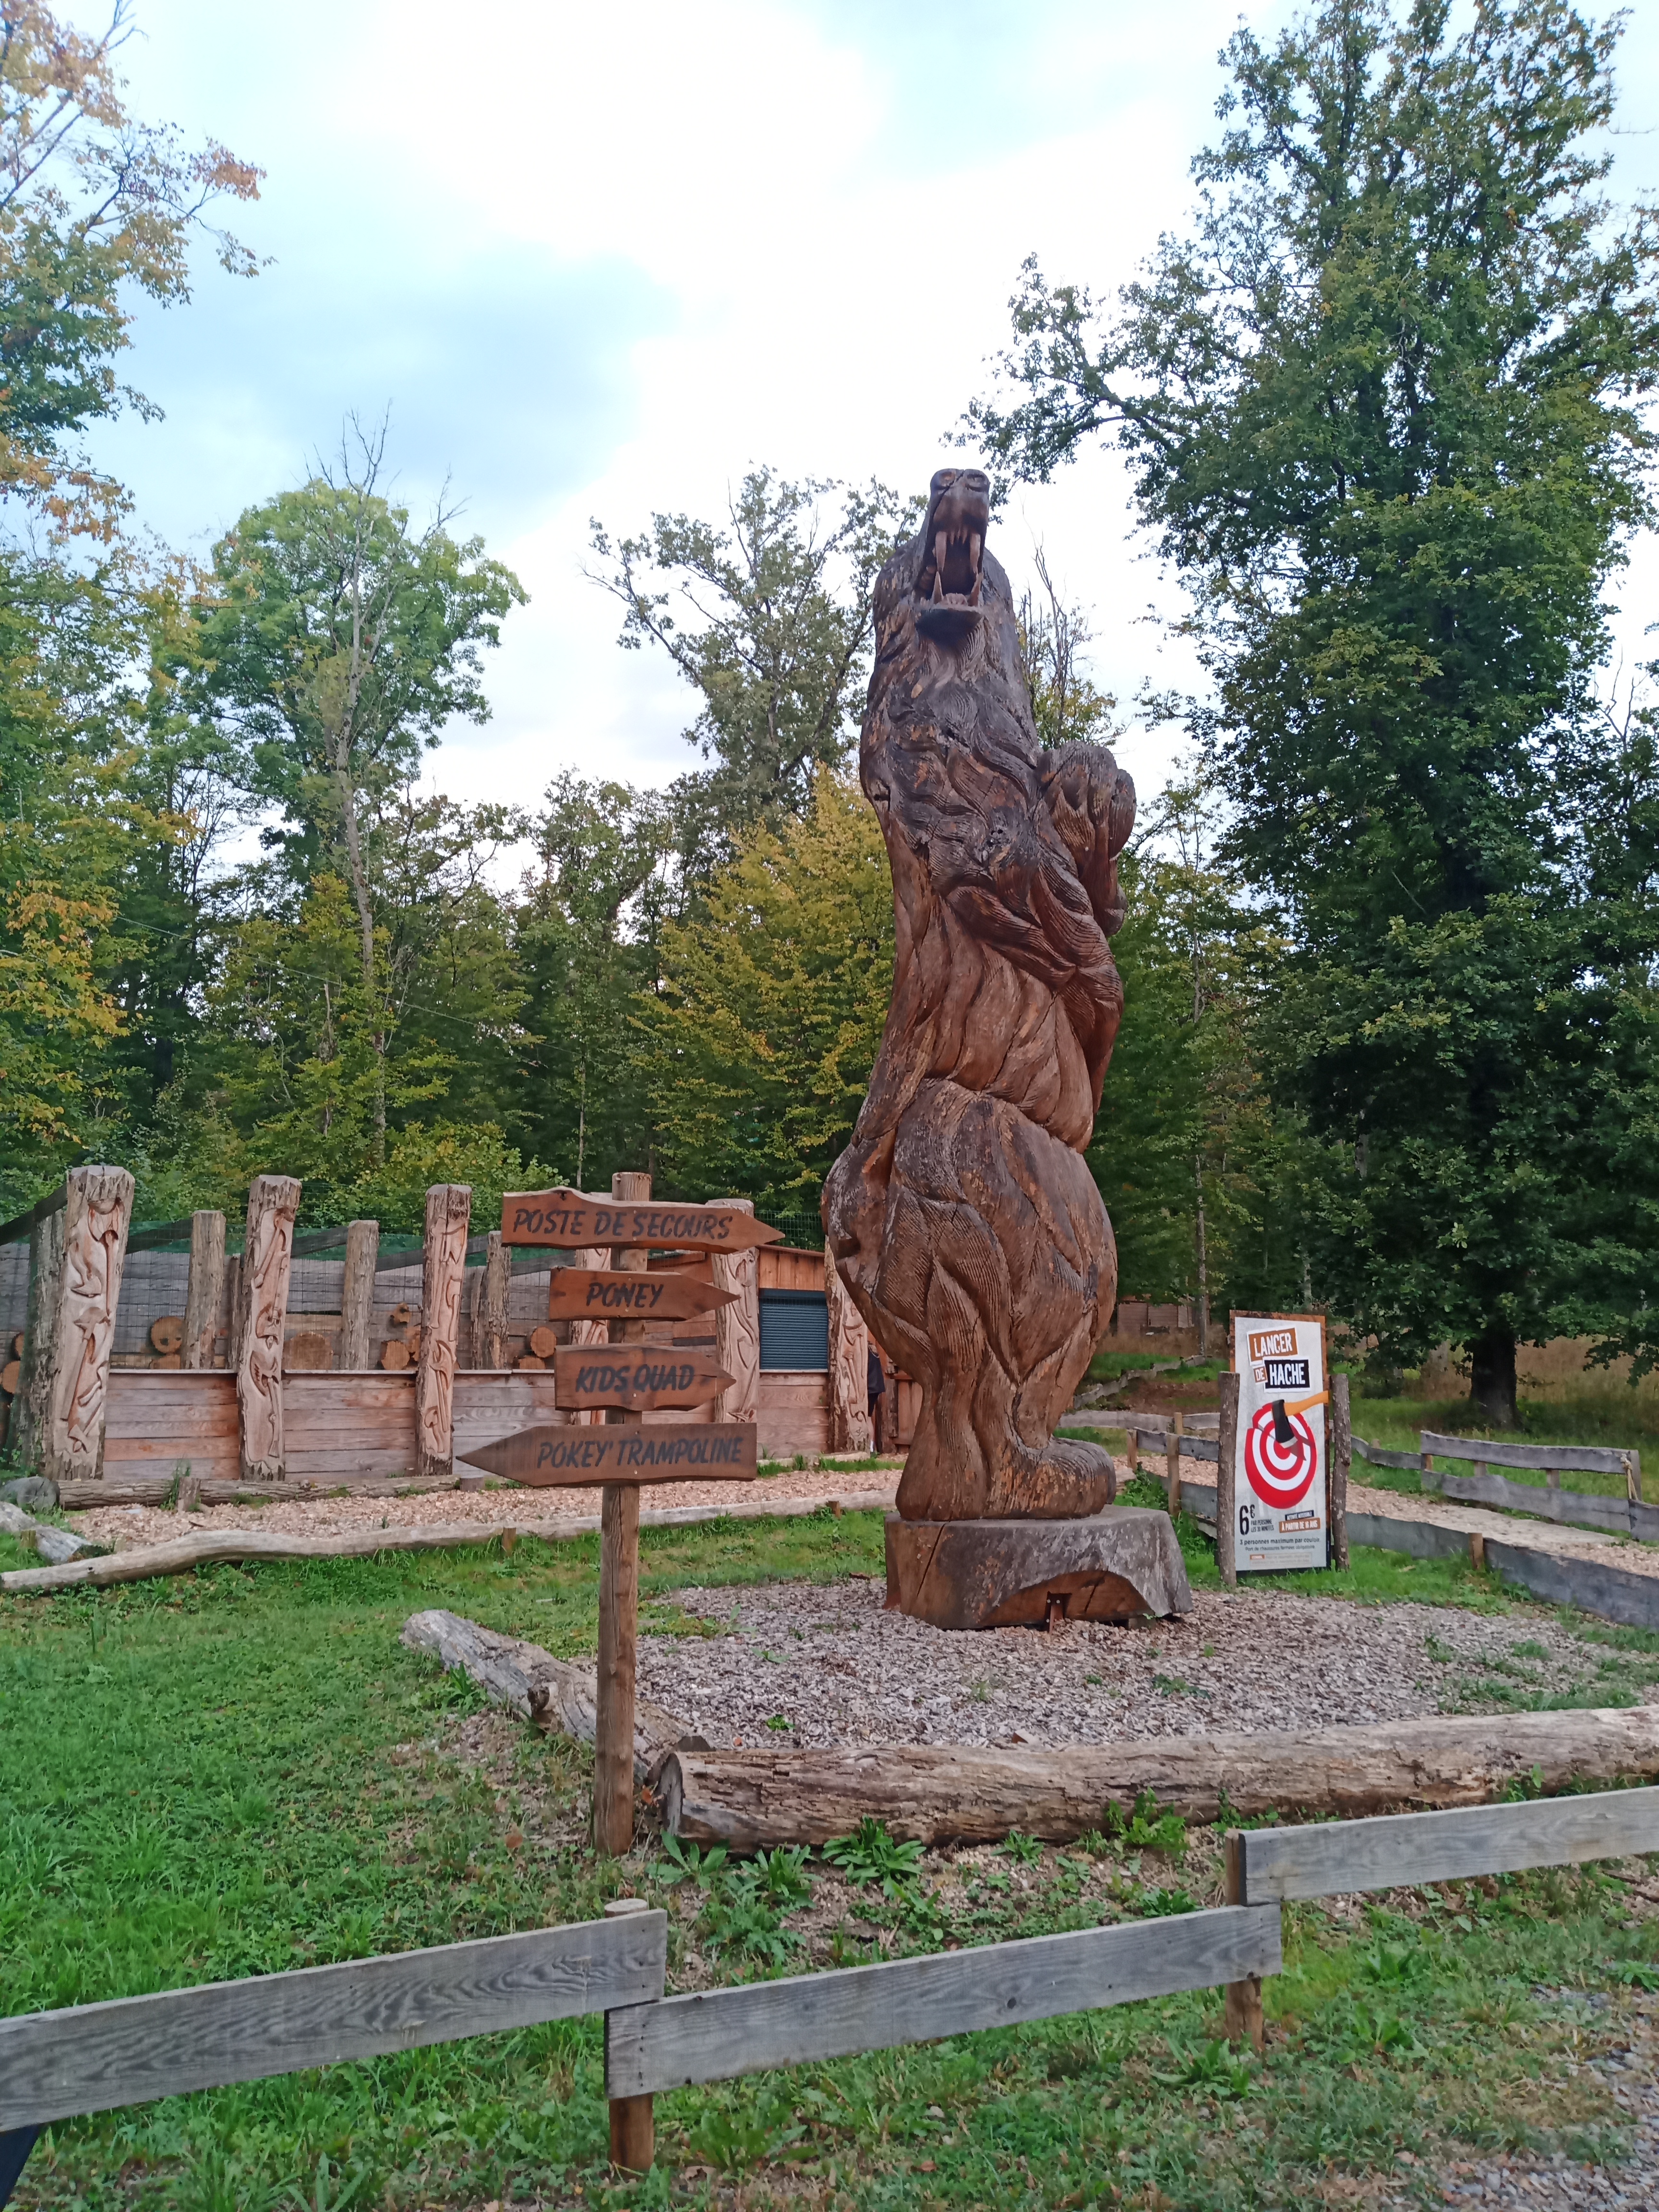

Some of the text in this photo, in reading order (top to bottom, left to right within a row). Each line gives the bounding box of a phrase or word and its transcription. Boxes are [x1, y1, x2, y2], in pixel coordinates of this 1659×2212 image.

[513, 1209, 733, 1240] POSTE DE SECOURS
[586, 1282, 663, 1308] PONEY
[1253, 1333, 1293, 1357] LANCER
[576, 1363, 695, 1392] KIDS QUAD
[1255, 1362, 1306, 1386] DE HACHE
[614, 1437, 744, 1466] TRAMPOLINE
[1285, 1522, 1299, 1531] PARTIR
[1299, 1521, 1305, 1529] DE
[1310, 1520, 1318, 1528] ANS
